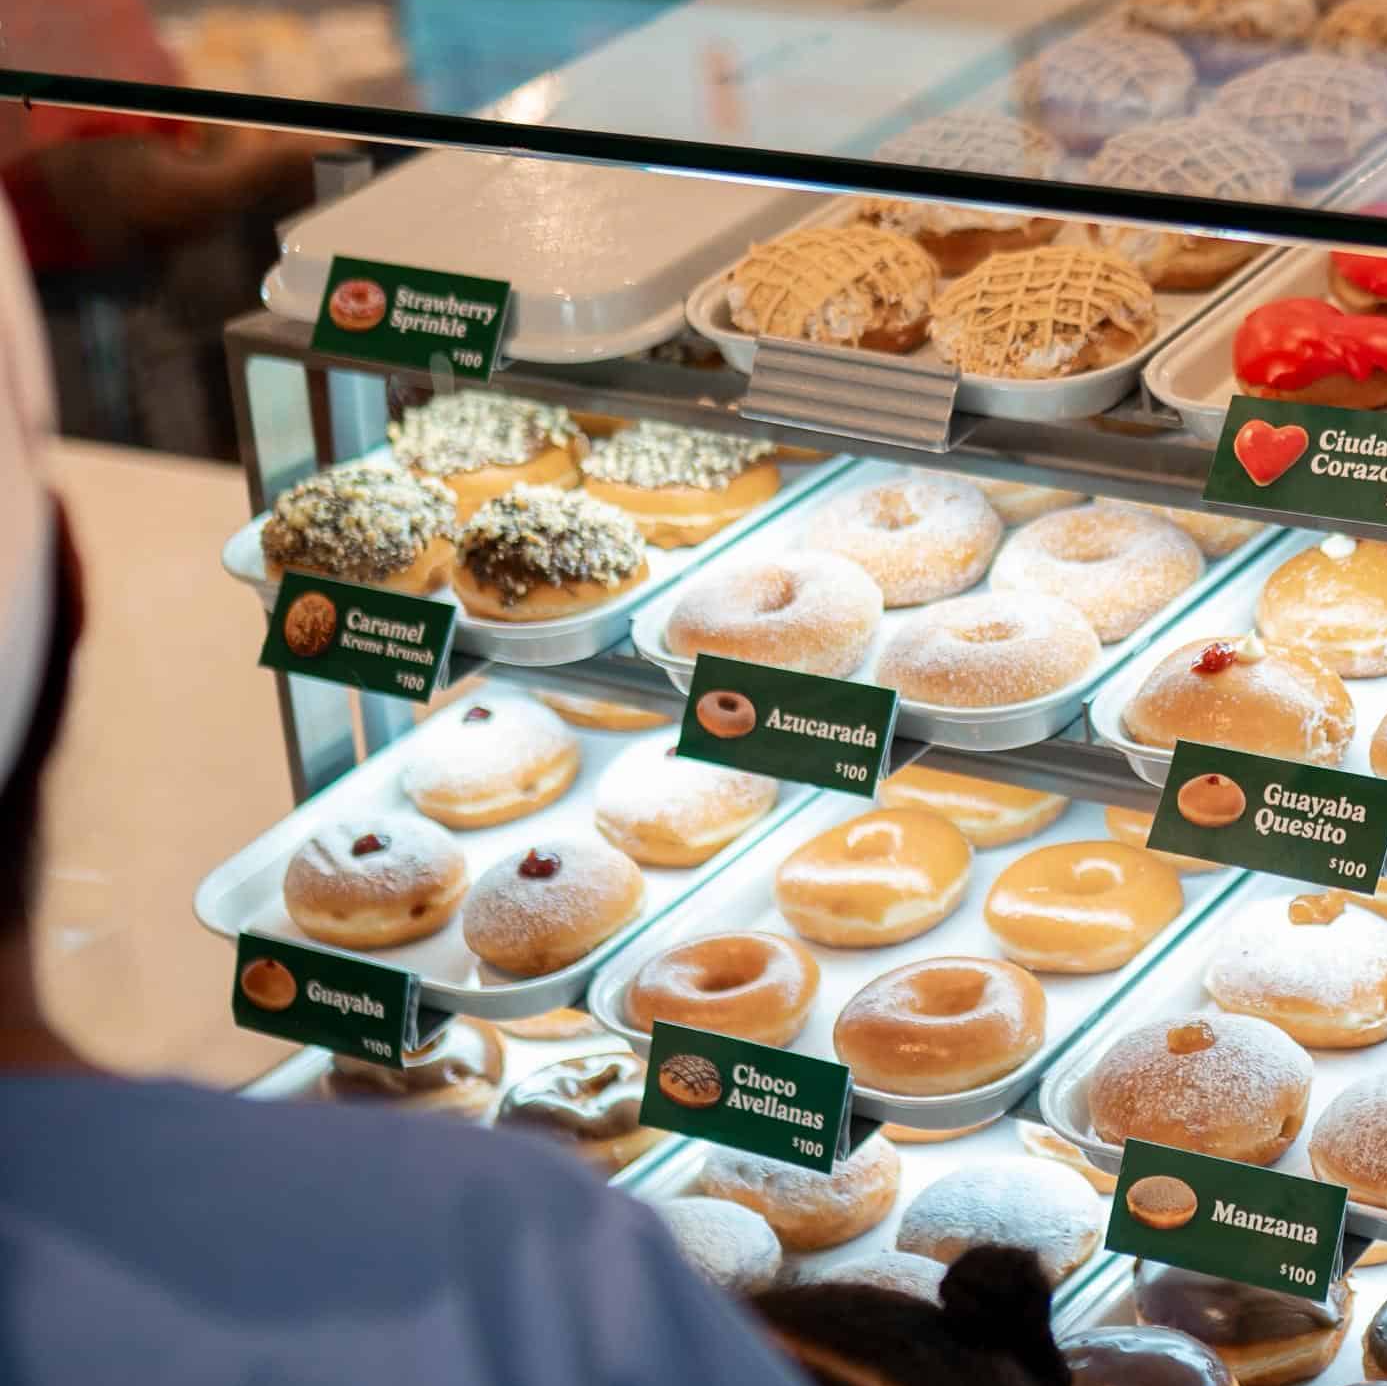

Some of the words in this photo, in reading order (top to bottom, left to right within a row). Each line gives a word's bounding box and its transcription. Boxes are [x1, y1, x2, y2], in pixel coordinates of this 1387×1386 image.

[395, 286, 497, 325] Strawberry
[390, 309, 467, 338] Sprinkle
[453, 350, 482, 368] $100
[346, 609, 425, 645] Caramel
[342, 631, 384, 654] Kreme
[385, 642, 434, 666] Krunch
[765, 706, 877, 748] Azucarada
[835, 762, 867, 782] $100
[1263, 783, 1366, 823] Guayaba
[1254, 808, 1347, 845] Quesito
[1329, 857, 1367, 878] $100
[307, 980, 385, 1020] Guayaba
[732, 1064, 797, 1098] Choco
[726, 1087, 824, 1130] Avellanas
[792, 1137, 824, 1158] $100
[1210, 1200, 1318, 1245] Manzana
[1280, 1263, 1317, 1286] $100
